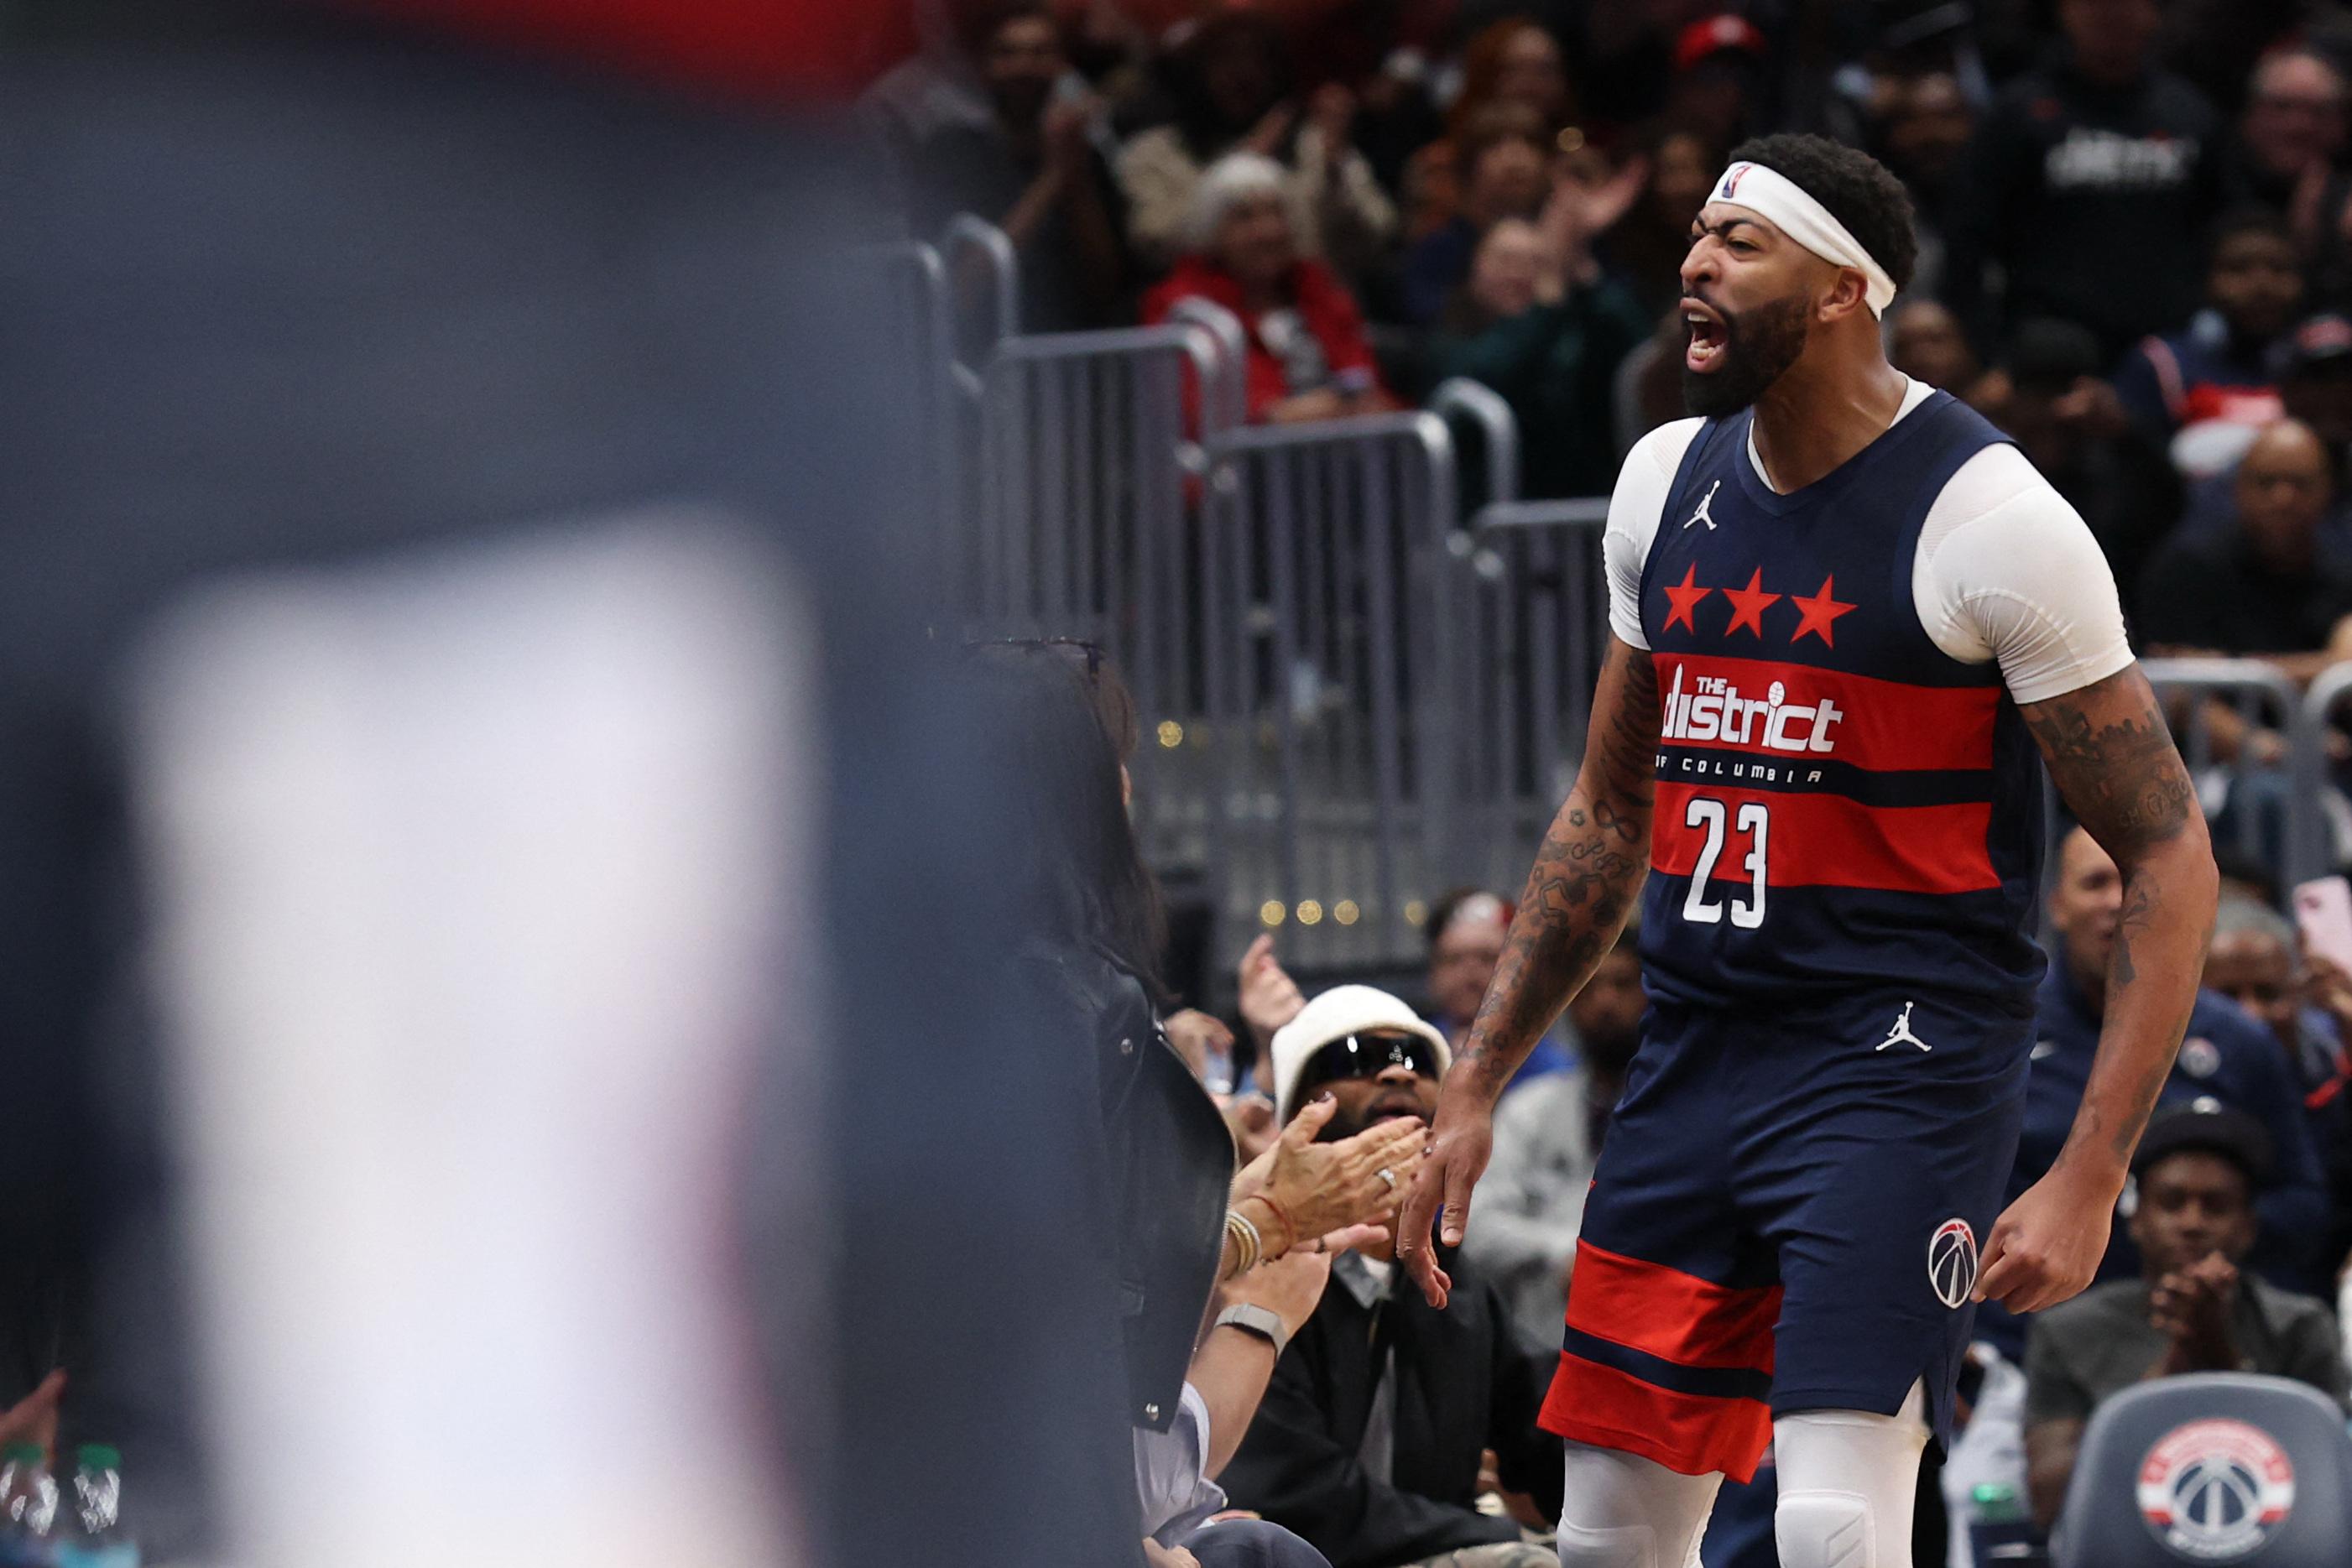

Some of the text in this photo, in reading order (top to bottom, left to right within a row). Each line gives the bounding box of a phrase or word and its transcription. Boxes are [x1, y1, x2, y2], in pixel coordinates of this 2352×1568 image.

[1661, 662, 1844, 753] district
[1696, 676, 1728, 695] THE
[1682, 758, 1822, 784] COLUMBIA
[1682, 799, 1769, 929] 23
